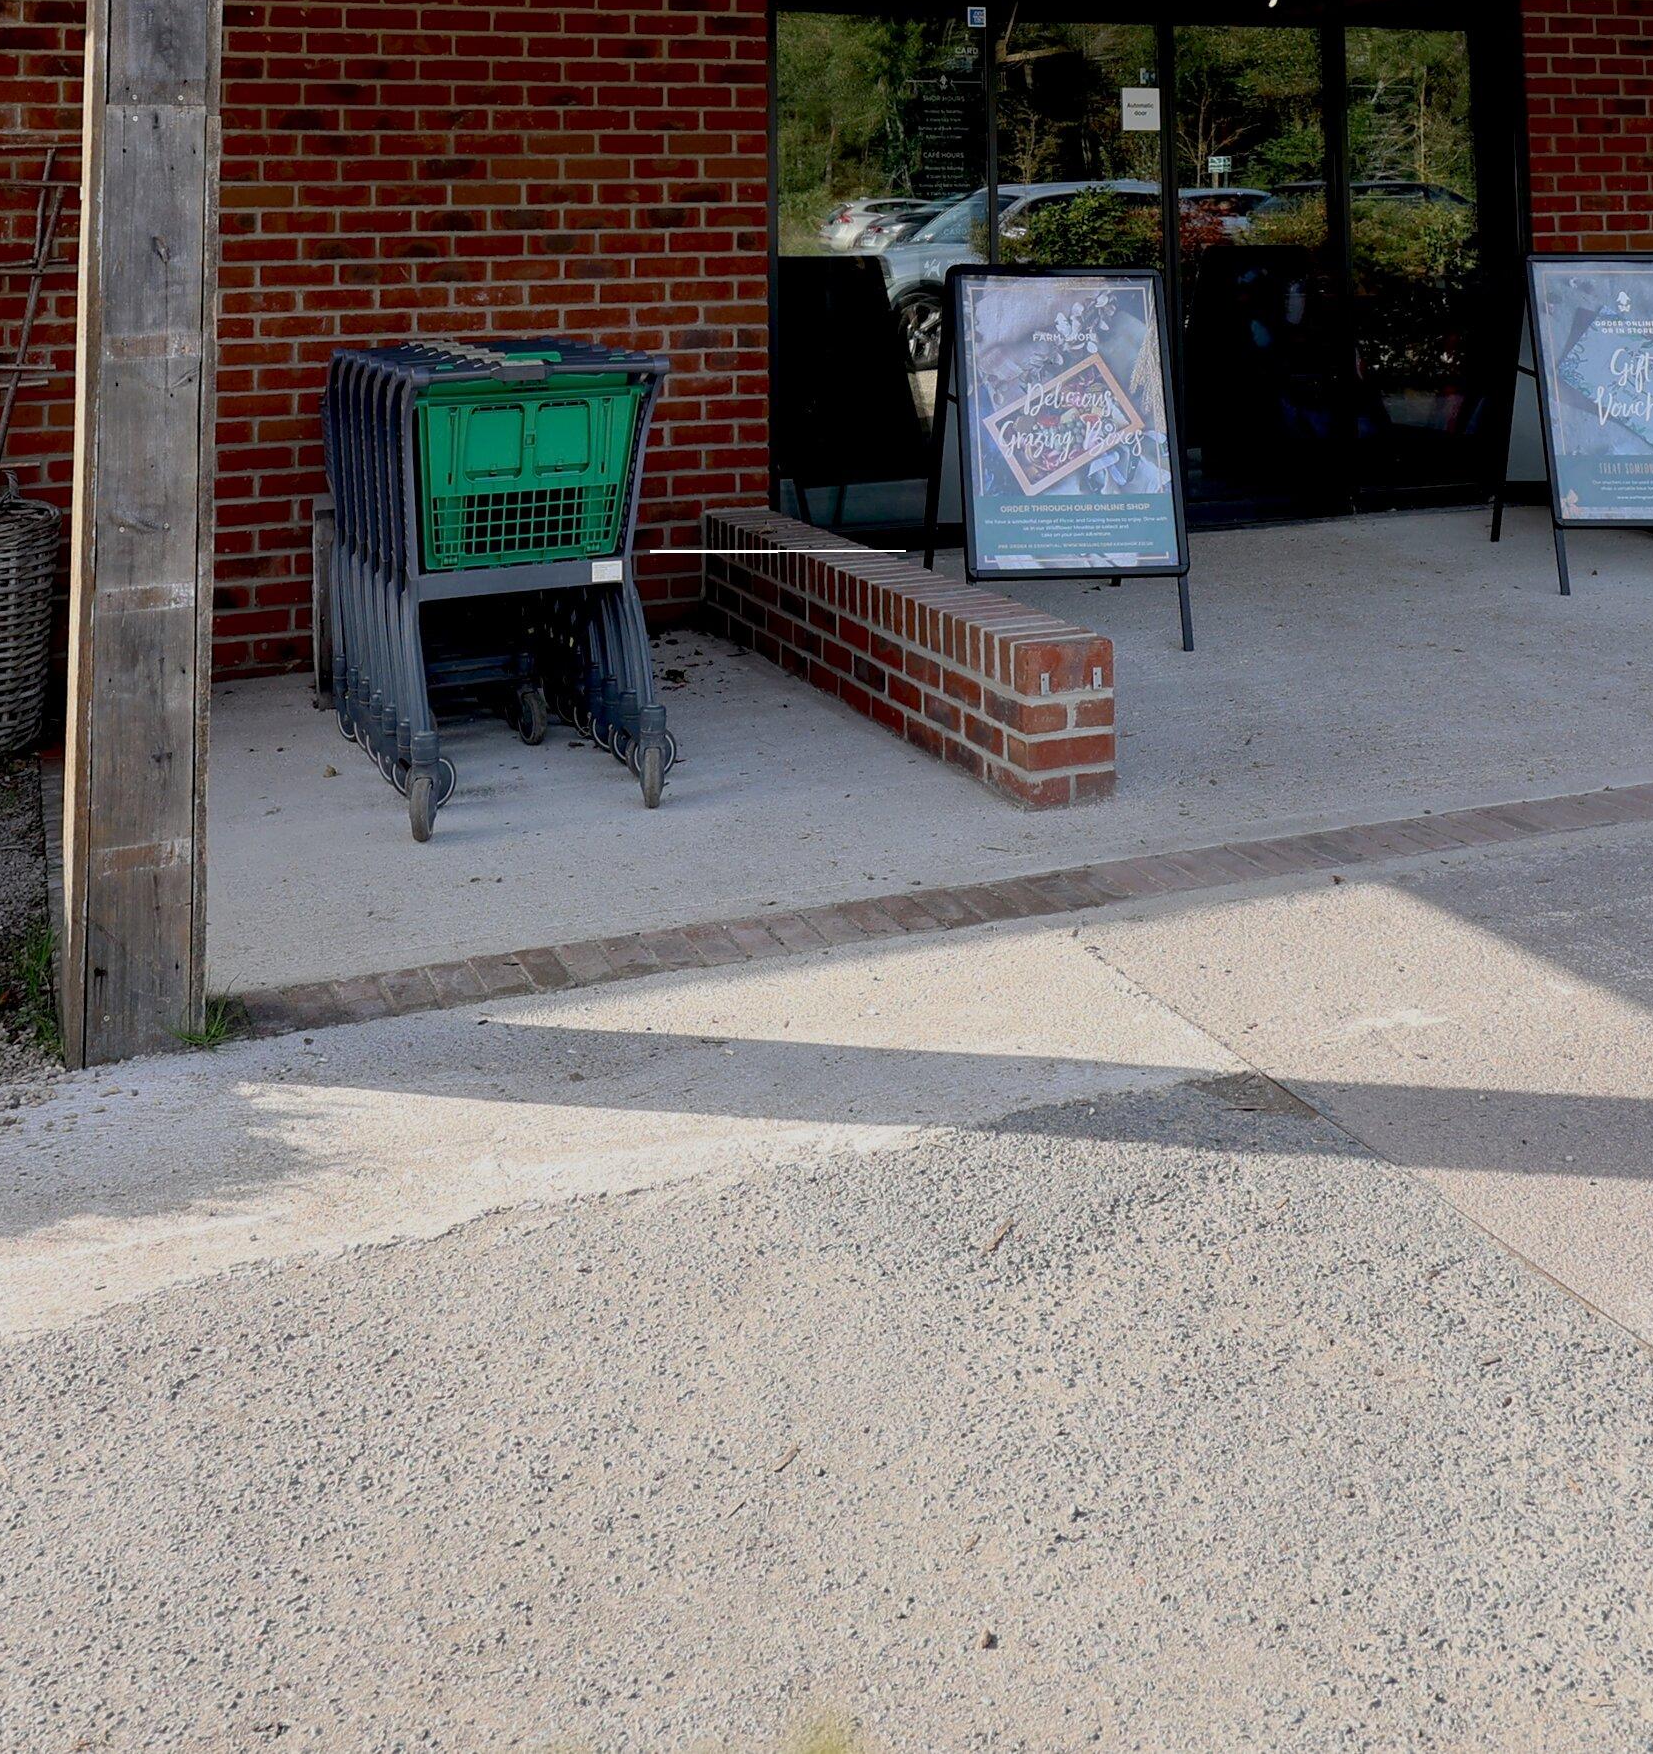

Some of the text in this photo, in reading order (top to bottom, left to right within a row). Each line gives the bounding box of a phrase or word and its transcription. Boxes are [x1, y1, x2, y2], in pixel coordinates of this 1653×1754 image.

[1032, 333, 1061, 342] FARM
[1023, 382, 1113, 417] Delicious
[998, 418, 1145, 462] Grazing Boxes
[1000, 503, 1150, 513] ORDER THROUGH OUR ONLINE SHOP
